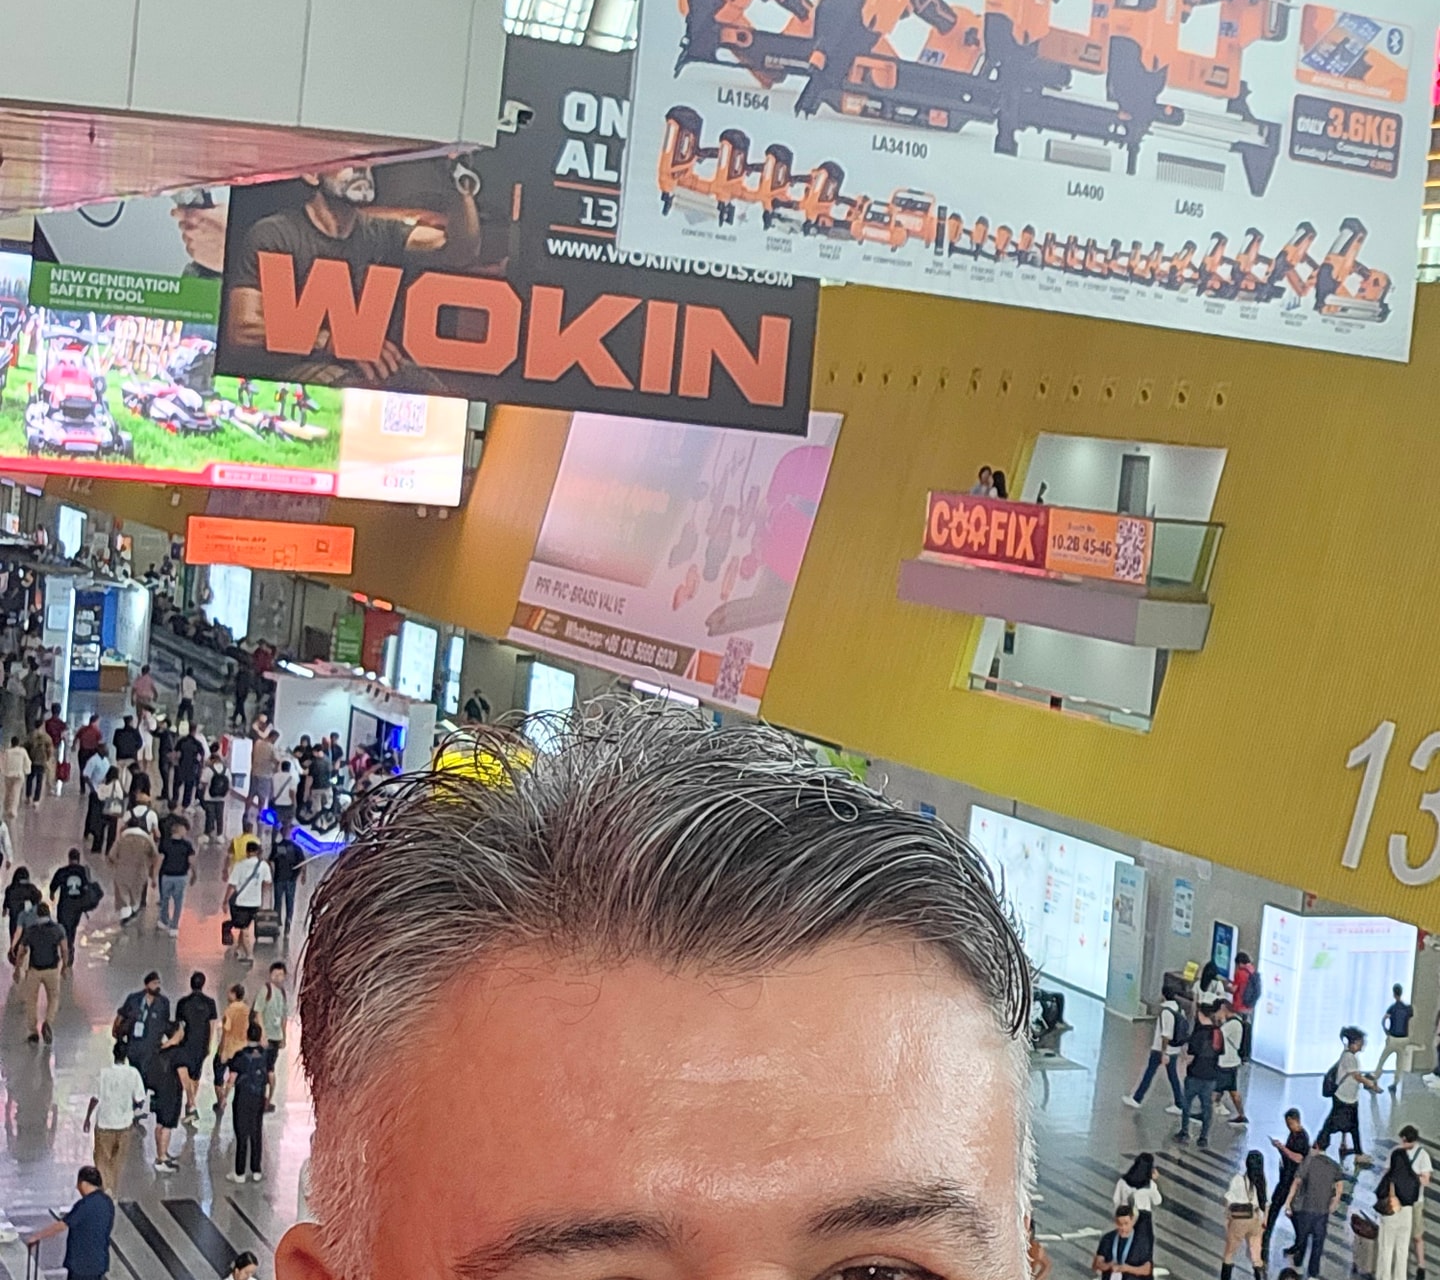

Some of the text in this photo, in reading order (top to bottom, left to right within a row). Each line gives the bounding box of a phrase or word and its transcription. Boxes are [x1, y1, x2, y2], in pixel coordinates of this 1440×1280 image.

[717, 87, 770, 111] LA1564
[1327, 106, 1397, 148] 3.6KG
[872, 135, 928, 159] LA34100
[1067, 181, 1104, 201] LA400
[1174, 199, 1204, 218] LA65
[50, 268, 180, 294] NEW GENERATION
[50, 282, 144, 304] SAFETY TOOL
[257, 251, 791, 407] WOKIN
[1052, 534, 1112, 557] 10.2B 45-46
[599, 594, 626, 615] VALVE
